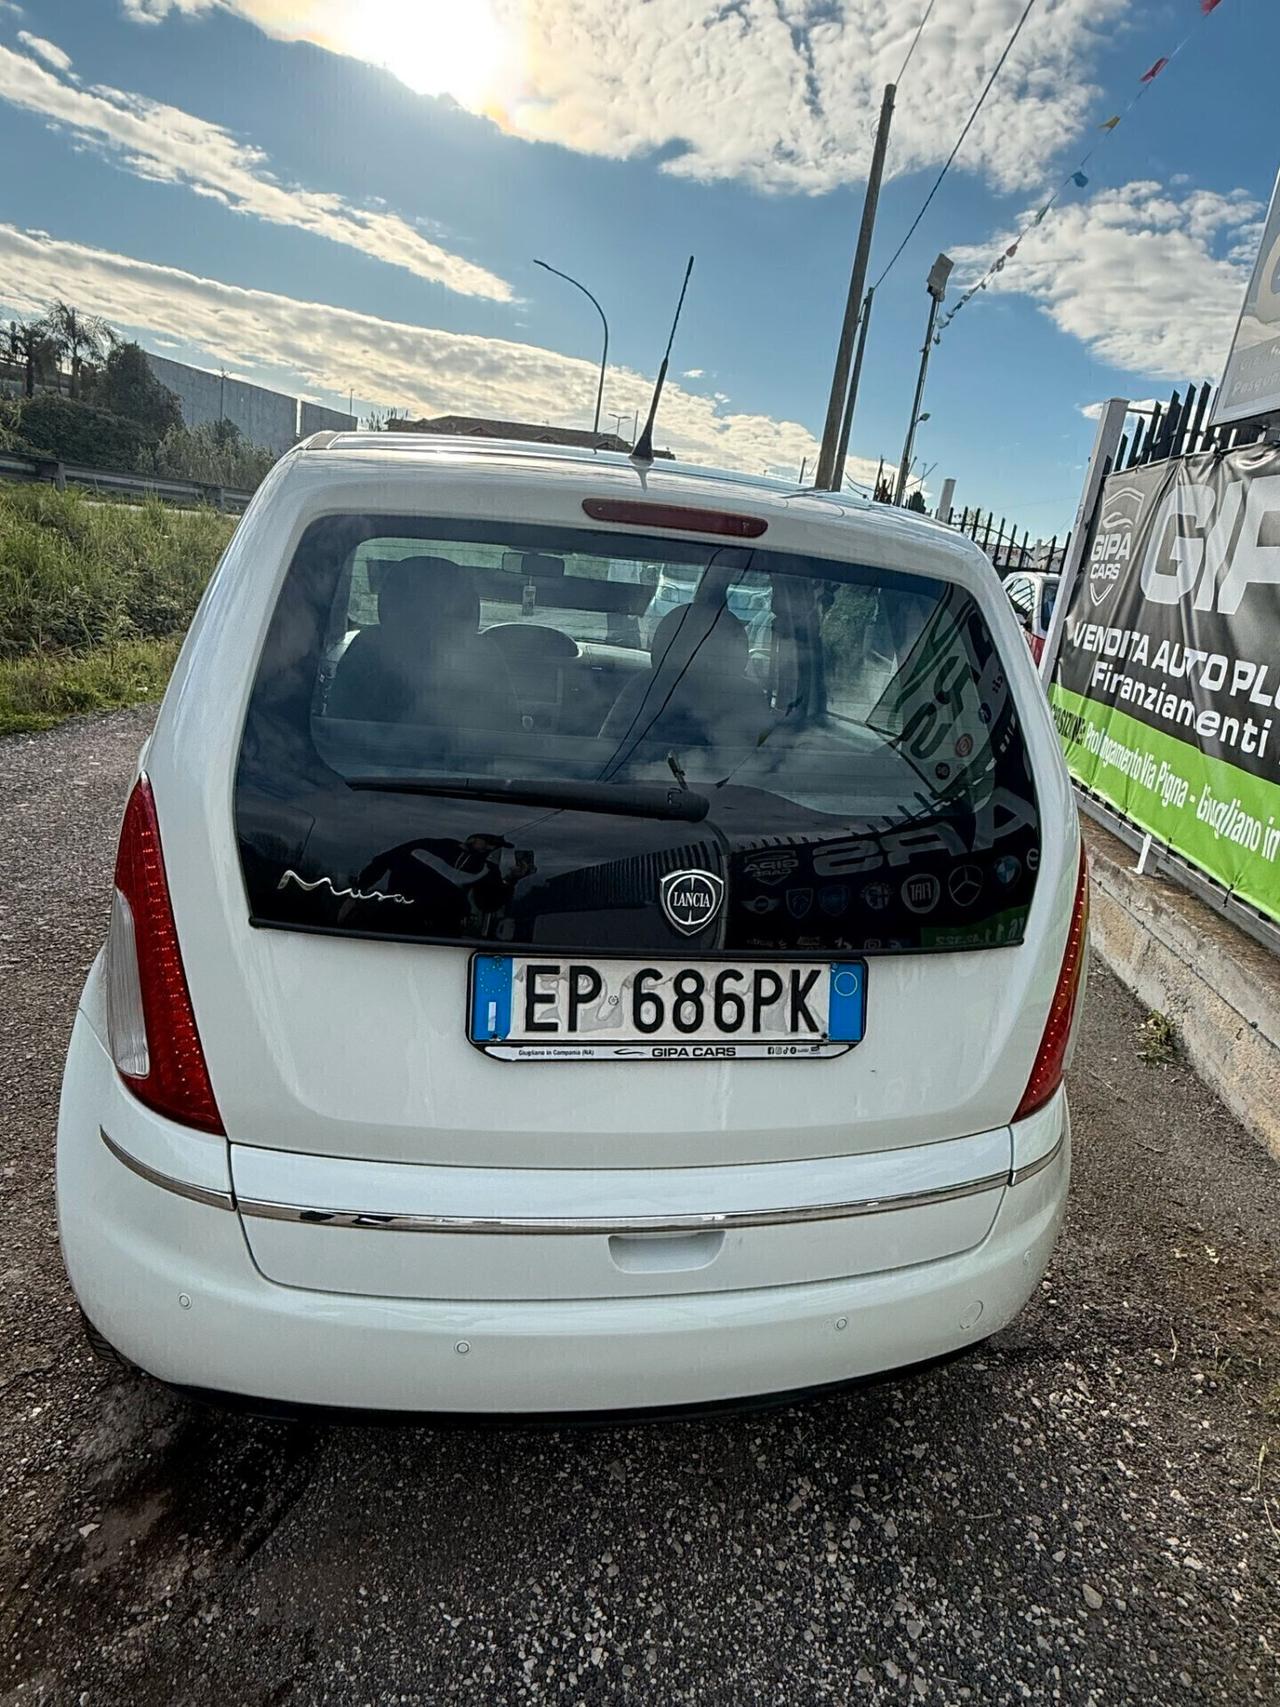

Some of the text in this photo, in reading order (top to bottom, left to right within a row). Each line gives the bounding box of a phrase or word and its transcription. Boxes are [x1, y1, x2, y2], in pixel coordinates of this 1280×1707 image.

[1091, 533, 1132, 561] GIPA
[1090, 563, 1120, 580] CARS
[1073, 621, 1280, 711] VENDITA AUTO PL
[1139, 751, 1158, 790] Via
[1154, 760, 1189, 808] Pigna
[673, 891, 711, 908] LANCIA
[524, 964, 822, 1034] EP 686PK
[652, 1047, 736, 1057] GIPA CARS
